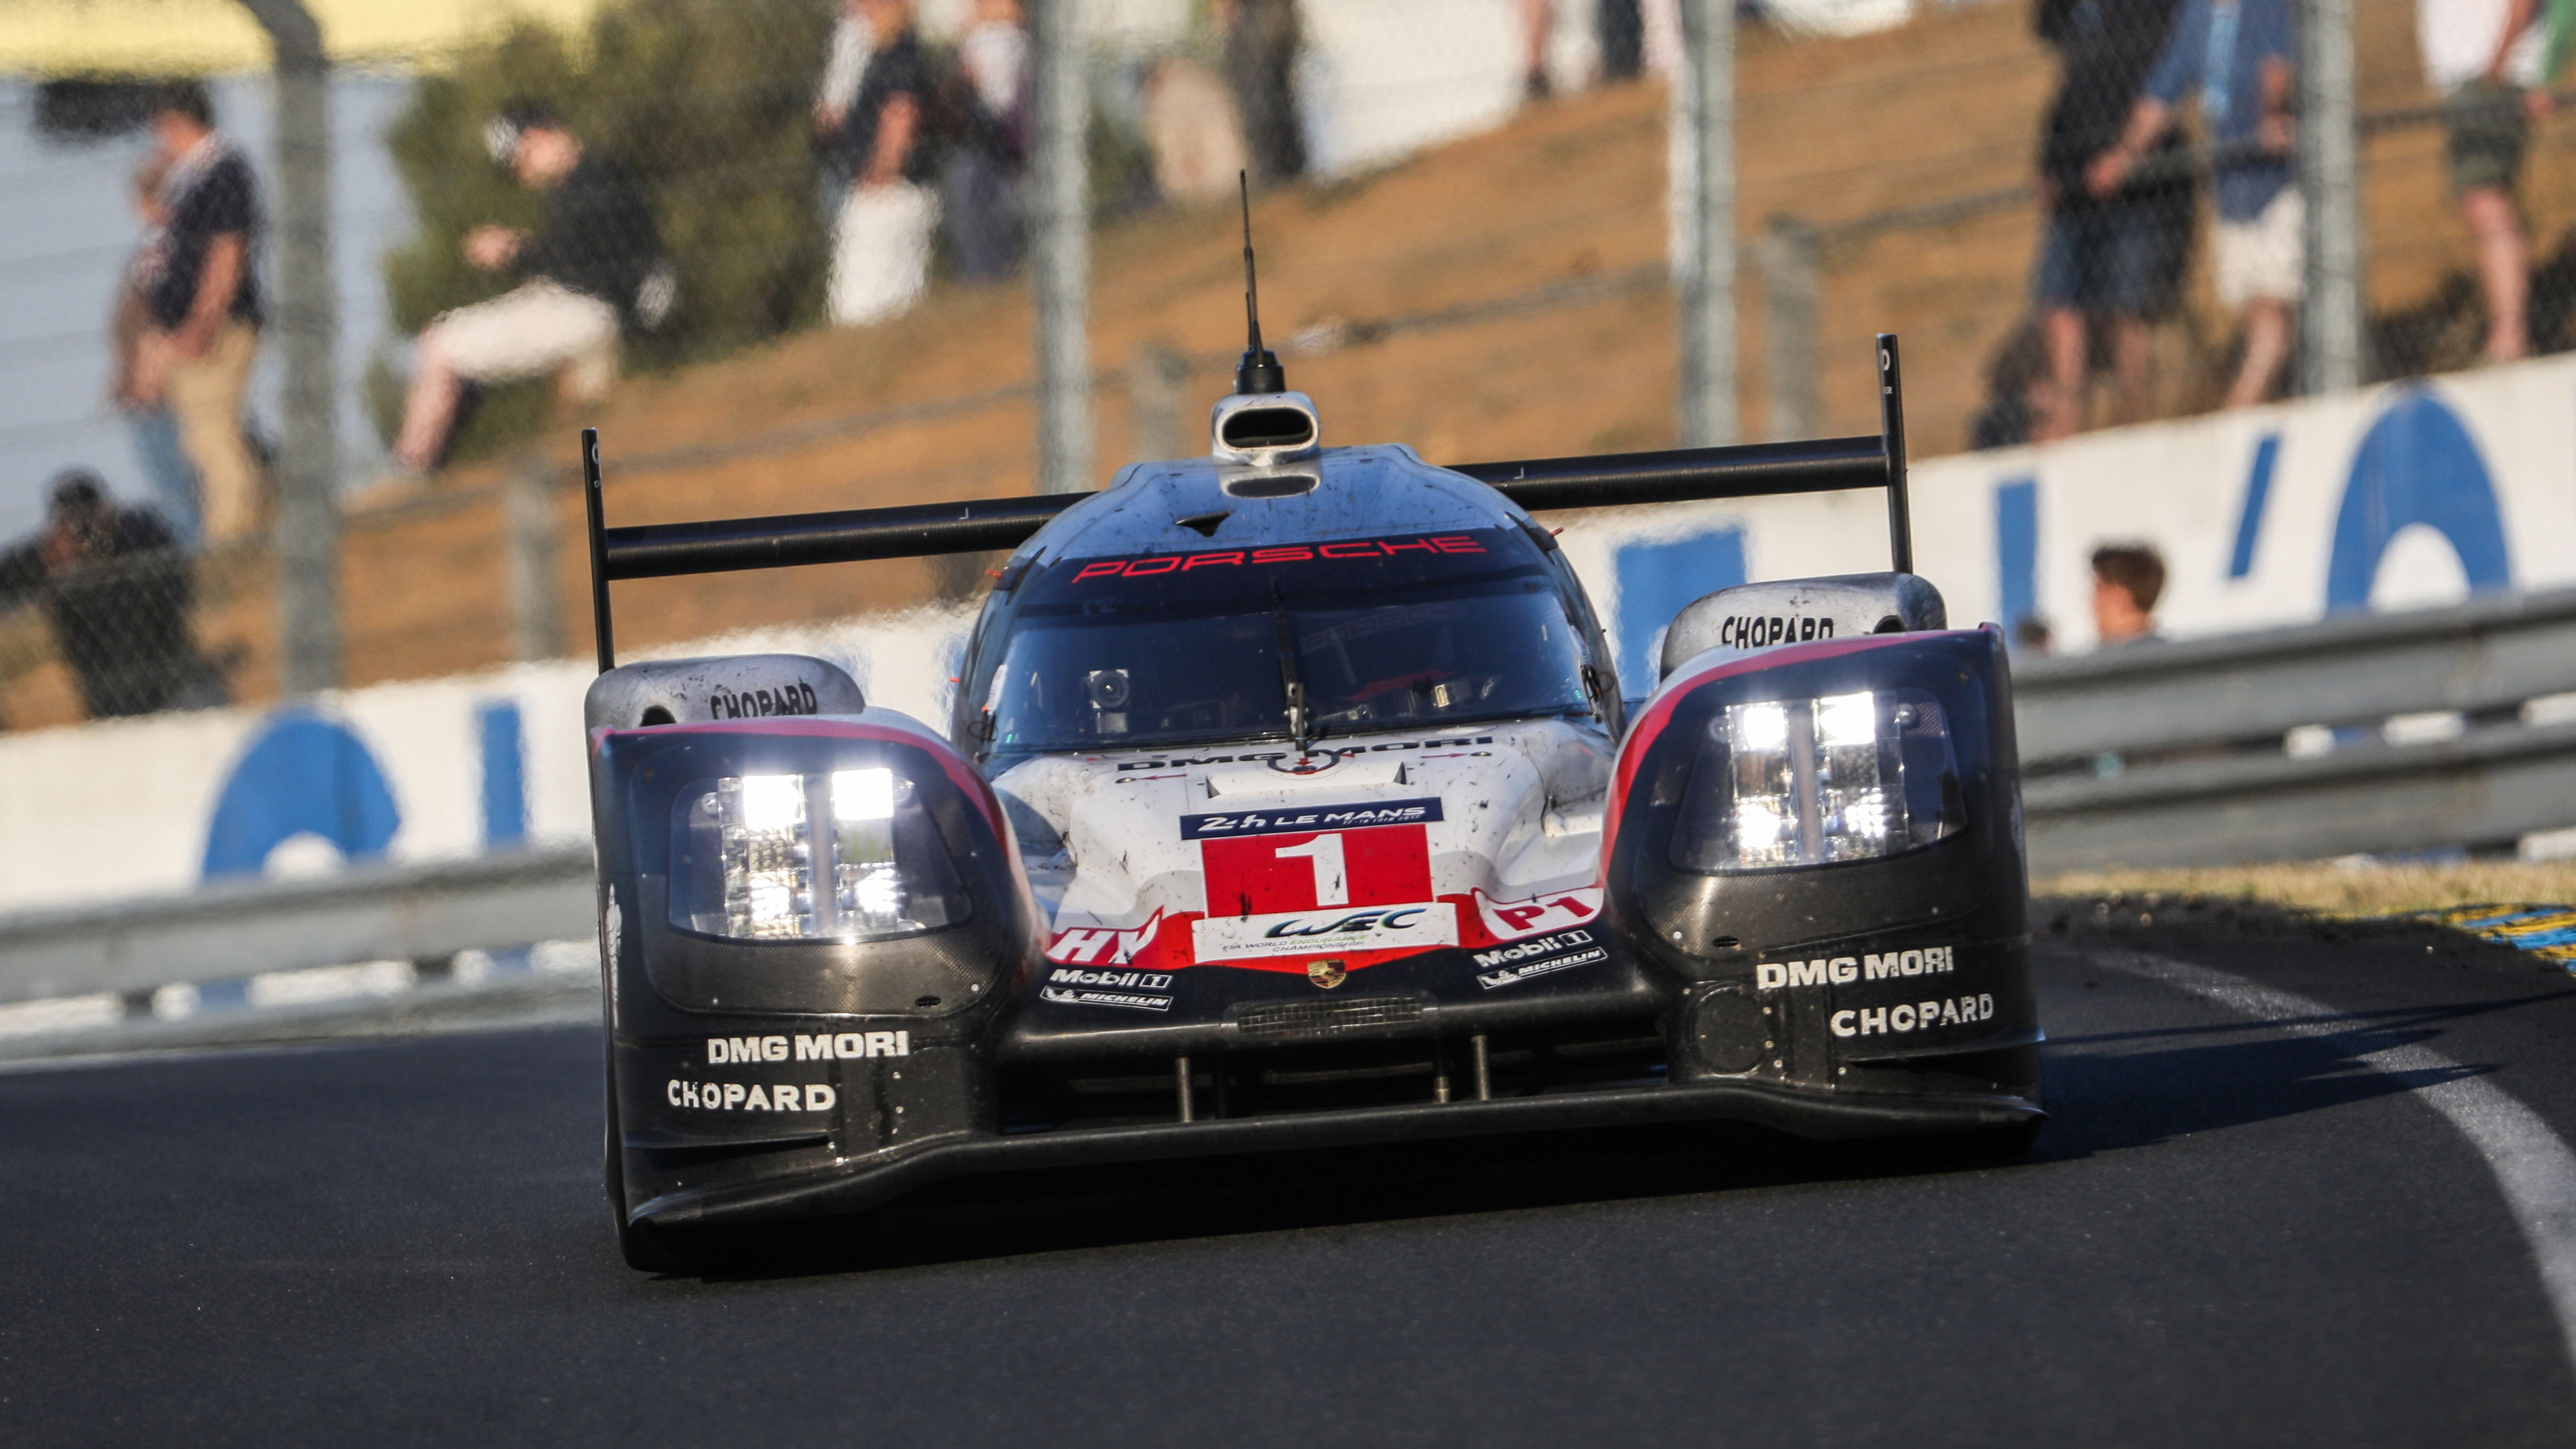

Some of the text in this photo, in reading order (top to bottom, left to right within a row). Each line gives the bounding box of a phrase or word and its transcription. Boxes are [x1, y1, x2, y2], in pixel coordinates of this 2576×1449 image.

[1072, 536, 1488, 584] PORSCHE
[1722, 616, 1834, 649] CHOPARD
[710, 682, 817, 719] CHOPARD
[1117, 736, 1492, 770] DMG MORI
[1275, 814, 1319, 826] LE
[1323, 807, 1426, 822] MANS
[1275, 833, 1349, 907] 1
[1265, 908, 1427, 938] WEC
[1492, 896, 1595, 931] P1
[1046, 913, 1161, 964] HY
[1272, 941, 1365, 952] CHAMPIONSHIP
[1289, 934, 1368, 945] ENDURANCE
[1473, 937, 1563, 968] Mobil
[1049, 969, 1140, 987] Mobil
[1518, 950, 1600, 974] MICHELIN
[1756, 946, 1954, 990] DMG MORI
[1081, 993, 1169, 1006] MICHELIN
[1830, 993, 1994, 1038] CHOPARD
[708, 1031, 910, 1065] DMG MORI
[668, 1079, 836, 1112] CHOPARD
